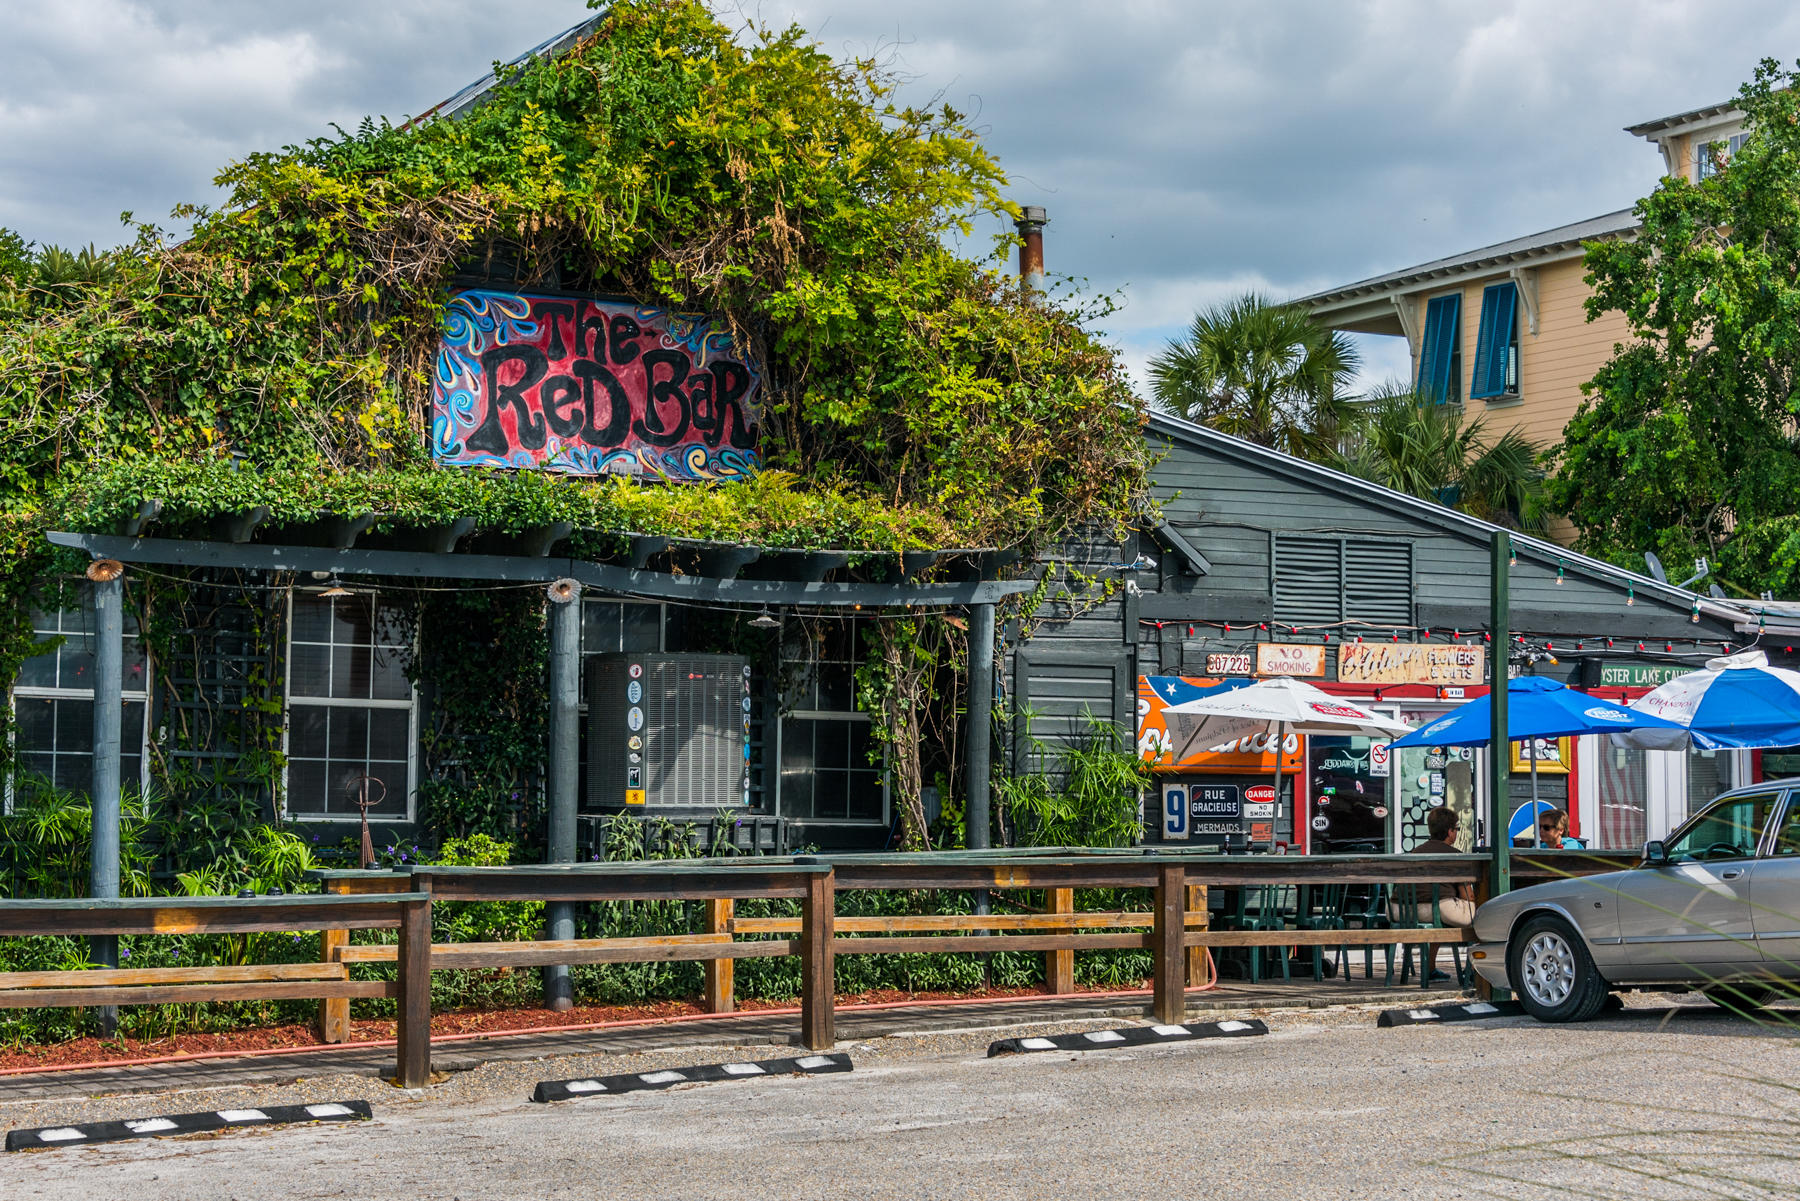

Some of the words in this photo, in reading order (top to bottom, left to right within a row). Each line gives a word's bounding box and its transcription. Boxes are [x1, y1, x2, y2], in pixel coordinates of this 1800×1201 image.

[533, 300, 641, 365] The
[1427, 651, 1478, 665] FLOWERS
[1267, 660, 1311, 673] SMOKING
[1601, 668, 1630, 683] YSTER
[1635, 669, 1661, 684] LAKE
[1204, 790, 1226, 800] RUE
[1247, 788, 1275, 798] DANGE
[1166, 790, 1185, 833] 9
[1192, 802, 1237, 812] GRACIEUSE
[1197, 823, 1240, 832] MERMAIDS
[1314, 819, 1326, 827] SIN
